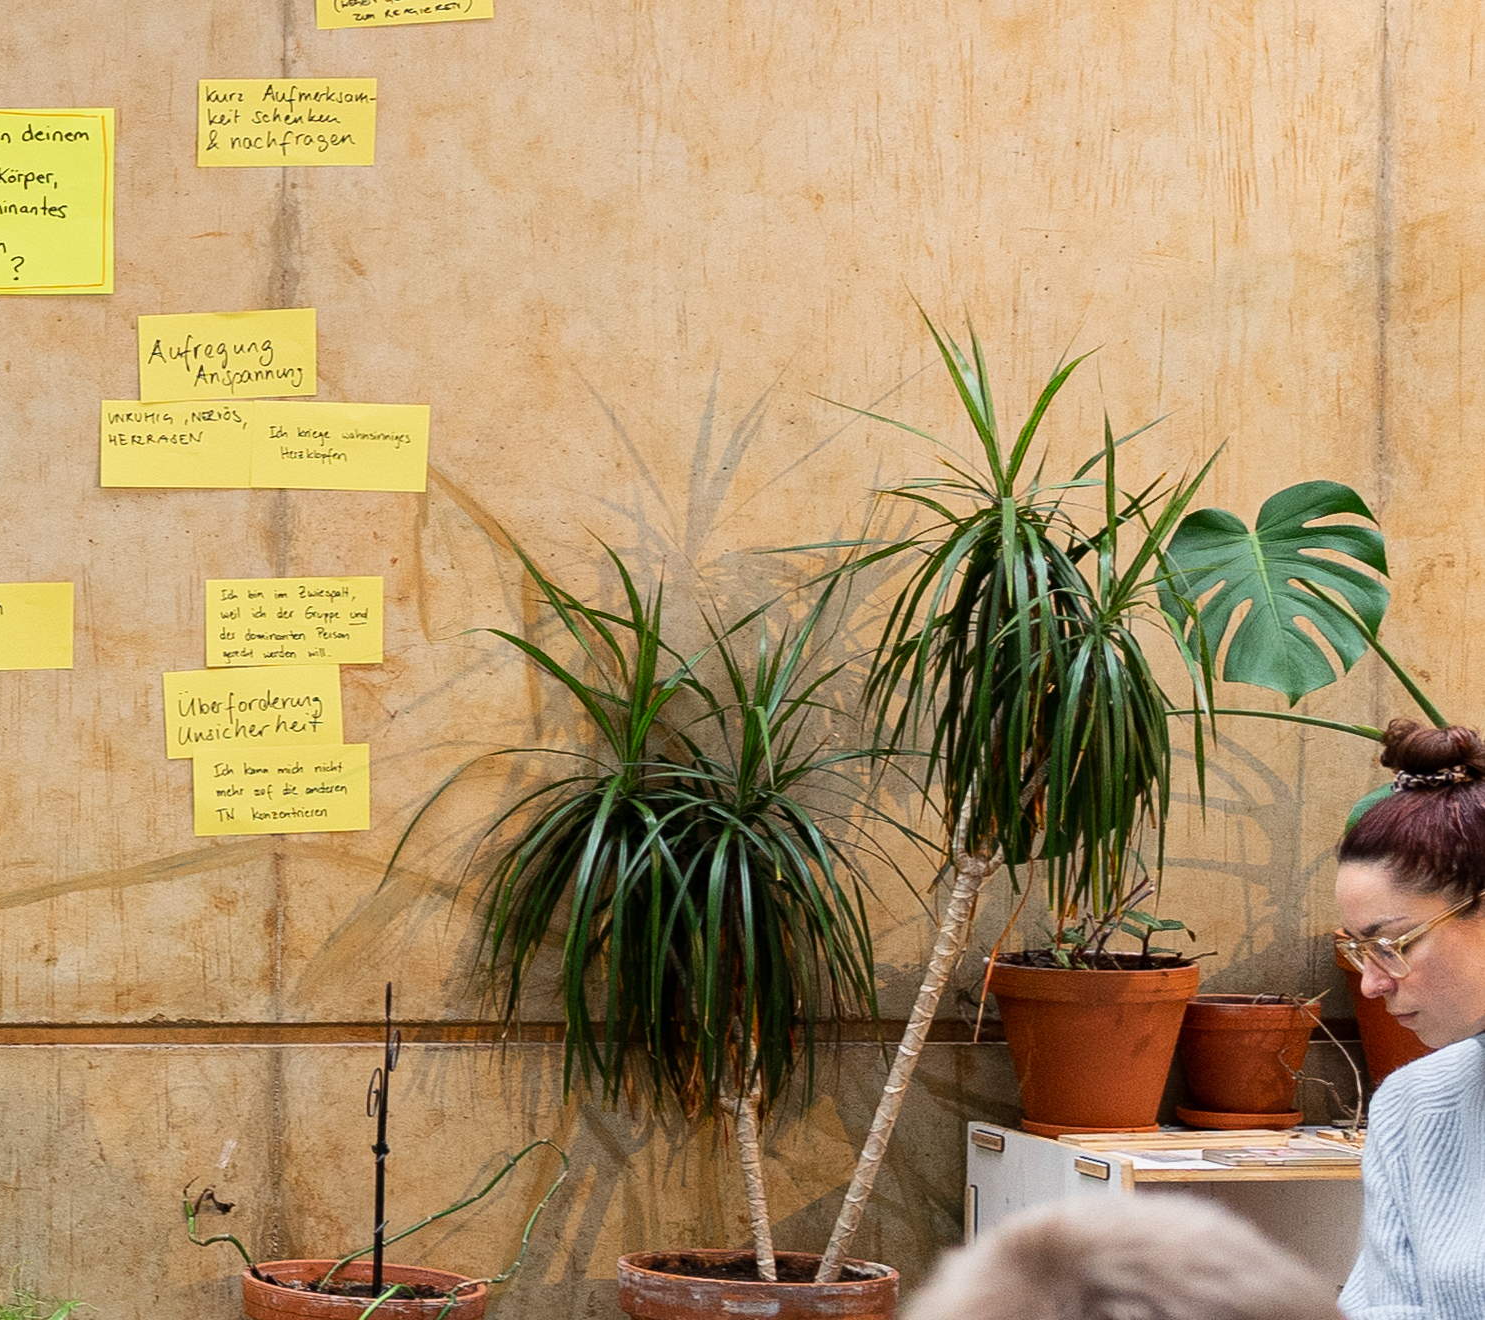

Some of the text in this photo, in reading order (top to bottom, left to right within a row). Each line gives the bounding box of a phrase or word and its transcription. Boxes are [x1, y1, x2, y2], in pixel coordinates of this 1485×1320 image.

[21, 123, 90, 142] deinem
[207, 108, 241, 126] keit
[230, 130, 356, 157] nachfragen
[147, 334, 274, 377] Aufregung
[193, 360, 303, 394] Anspannung
[178, 689, 324, 729] Überforderung
[178, 708, 324, 746] Unsicherheit
